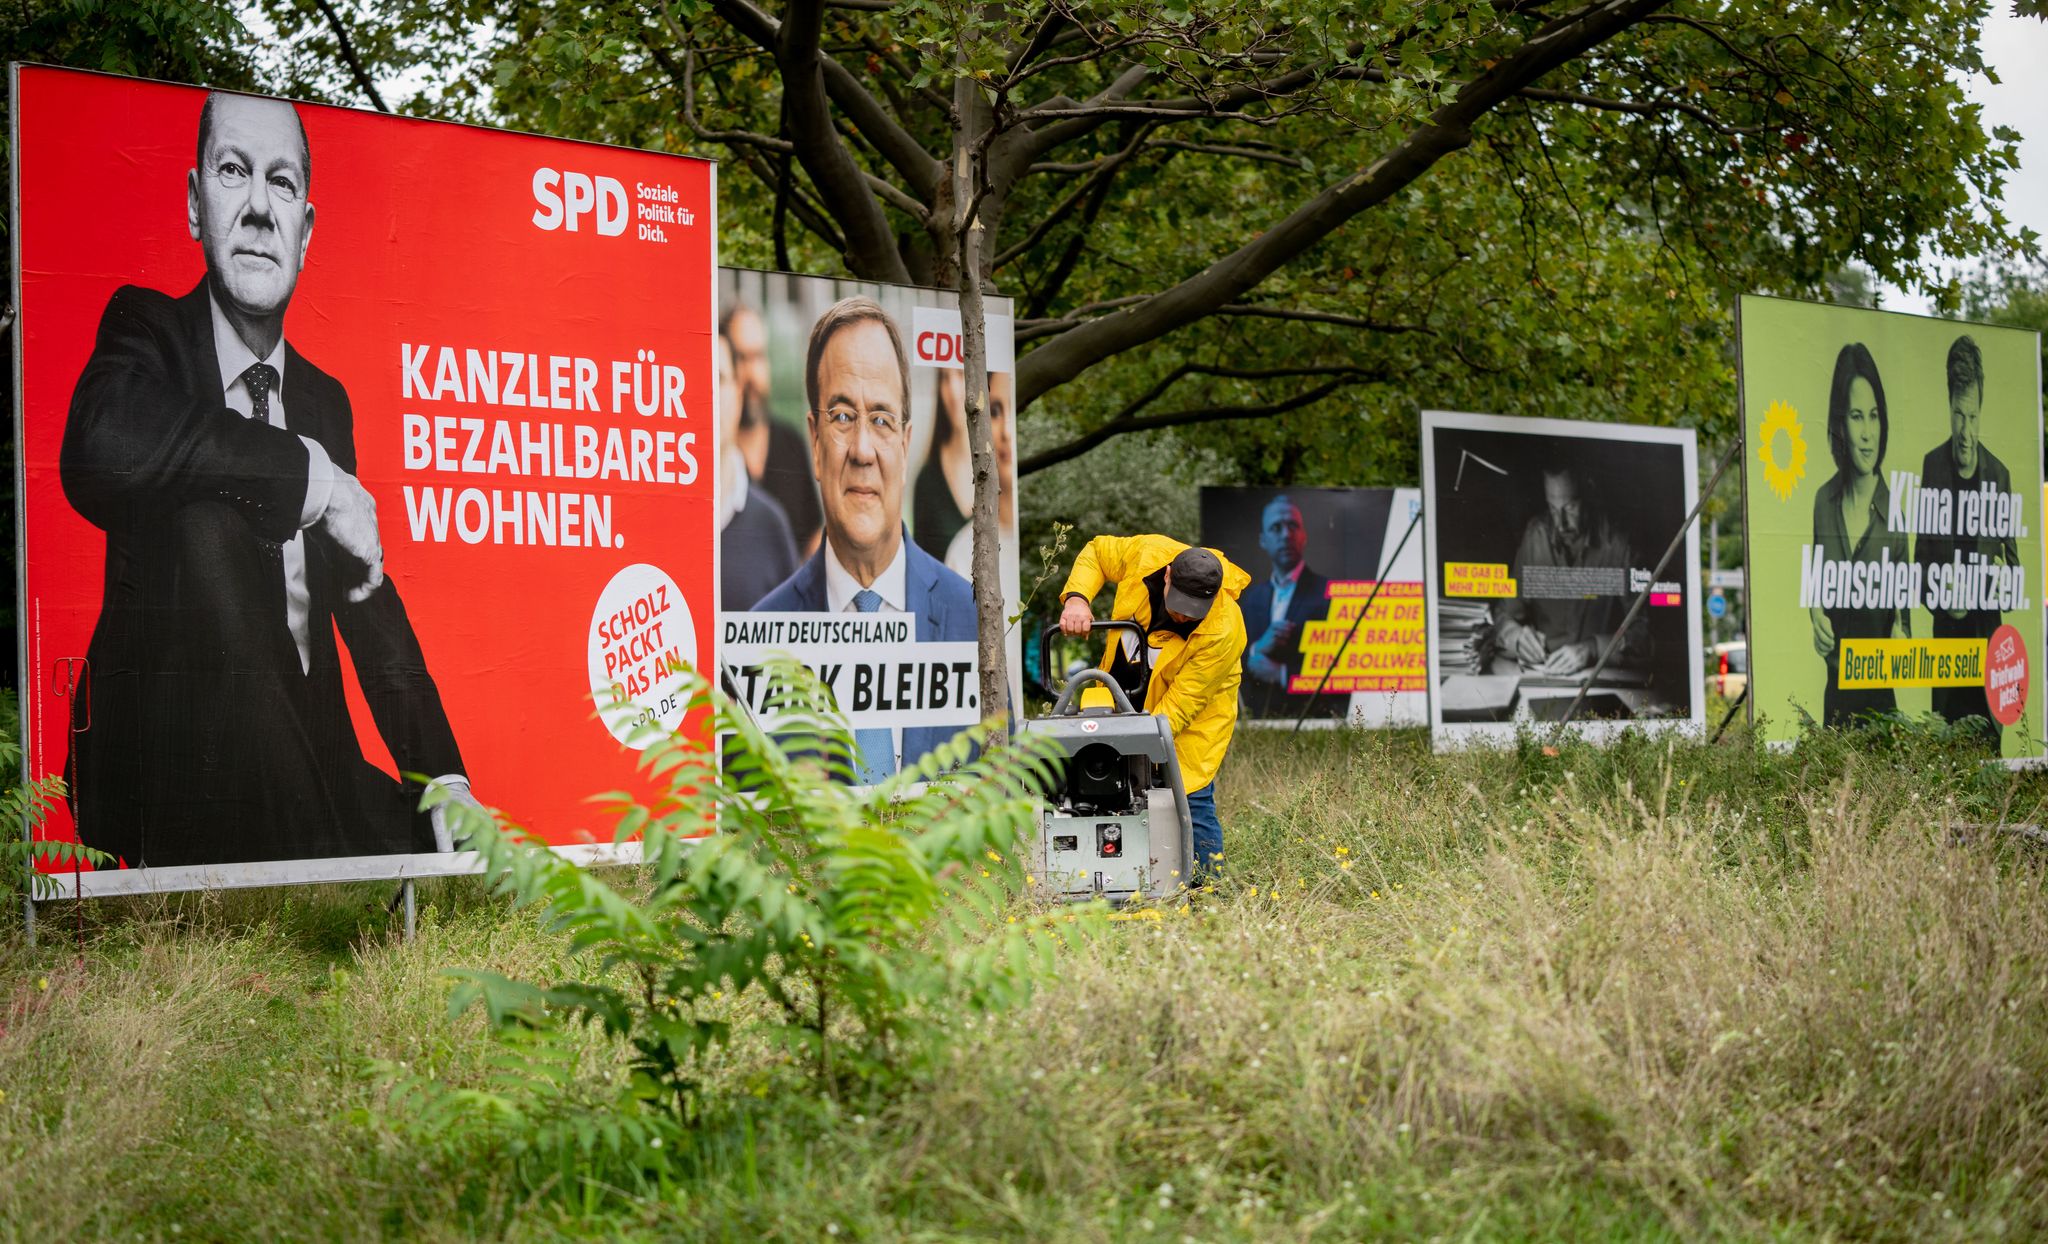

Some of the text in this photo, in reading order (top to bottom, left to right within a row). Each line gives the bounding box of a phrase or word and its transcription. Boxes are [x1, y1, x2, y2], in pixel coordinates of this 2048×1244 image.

[532, 167, 630, 237] SPD
[636, 182, 679, 203] Soziale
[637, 203, 695, 226] Politik für
[638, 223, 668, 243] Dich.
[401, 343, 688, 418] KANZLER FÜR
[403, 413, 699, 486] BEZAHLBARES
[402, 485, 625, 549] WOHNEN.
[1887, 470, 2028, 538] Klima retten.
[1448, 582, 1474, 593] MEHR
[1476, 582, 1490, 594] ZU
[1453, 566, 1468, 578] NIE
[1471, 566, 1491, 578] GAB
[1799, 544, 2030, 611] Menschen schützen.
[598, 584, 671, 649] SCHOLZ
[724, 621, 908, 644] DAMIT DEUTSCHLAND
[1393, 604, 1422, 621] DIE
[604, 621, 664, 680] PACKT
[1844, 646, 1982, 683] Bereit, weil Ihr es seid.
[611, 665, 650, 709] DAS
[852, 662, 977, 712] BLEIBT.
